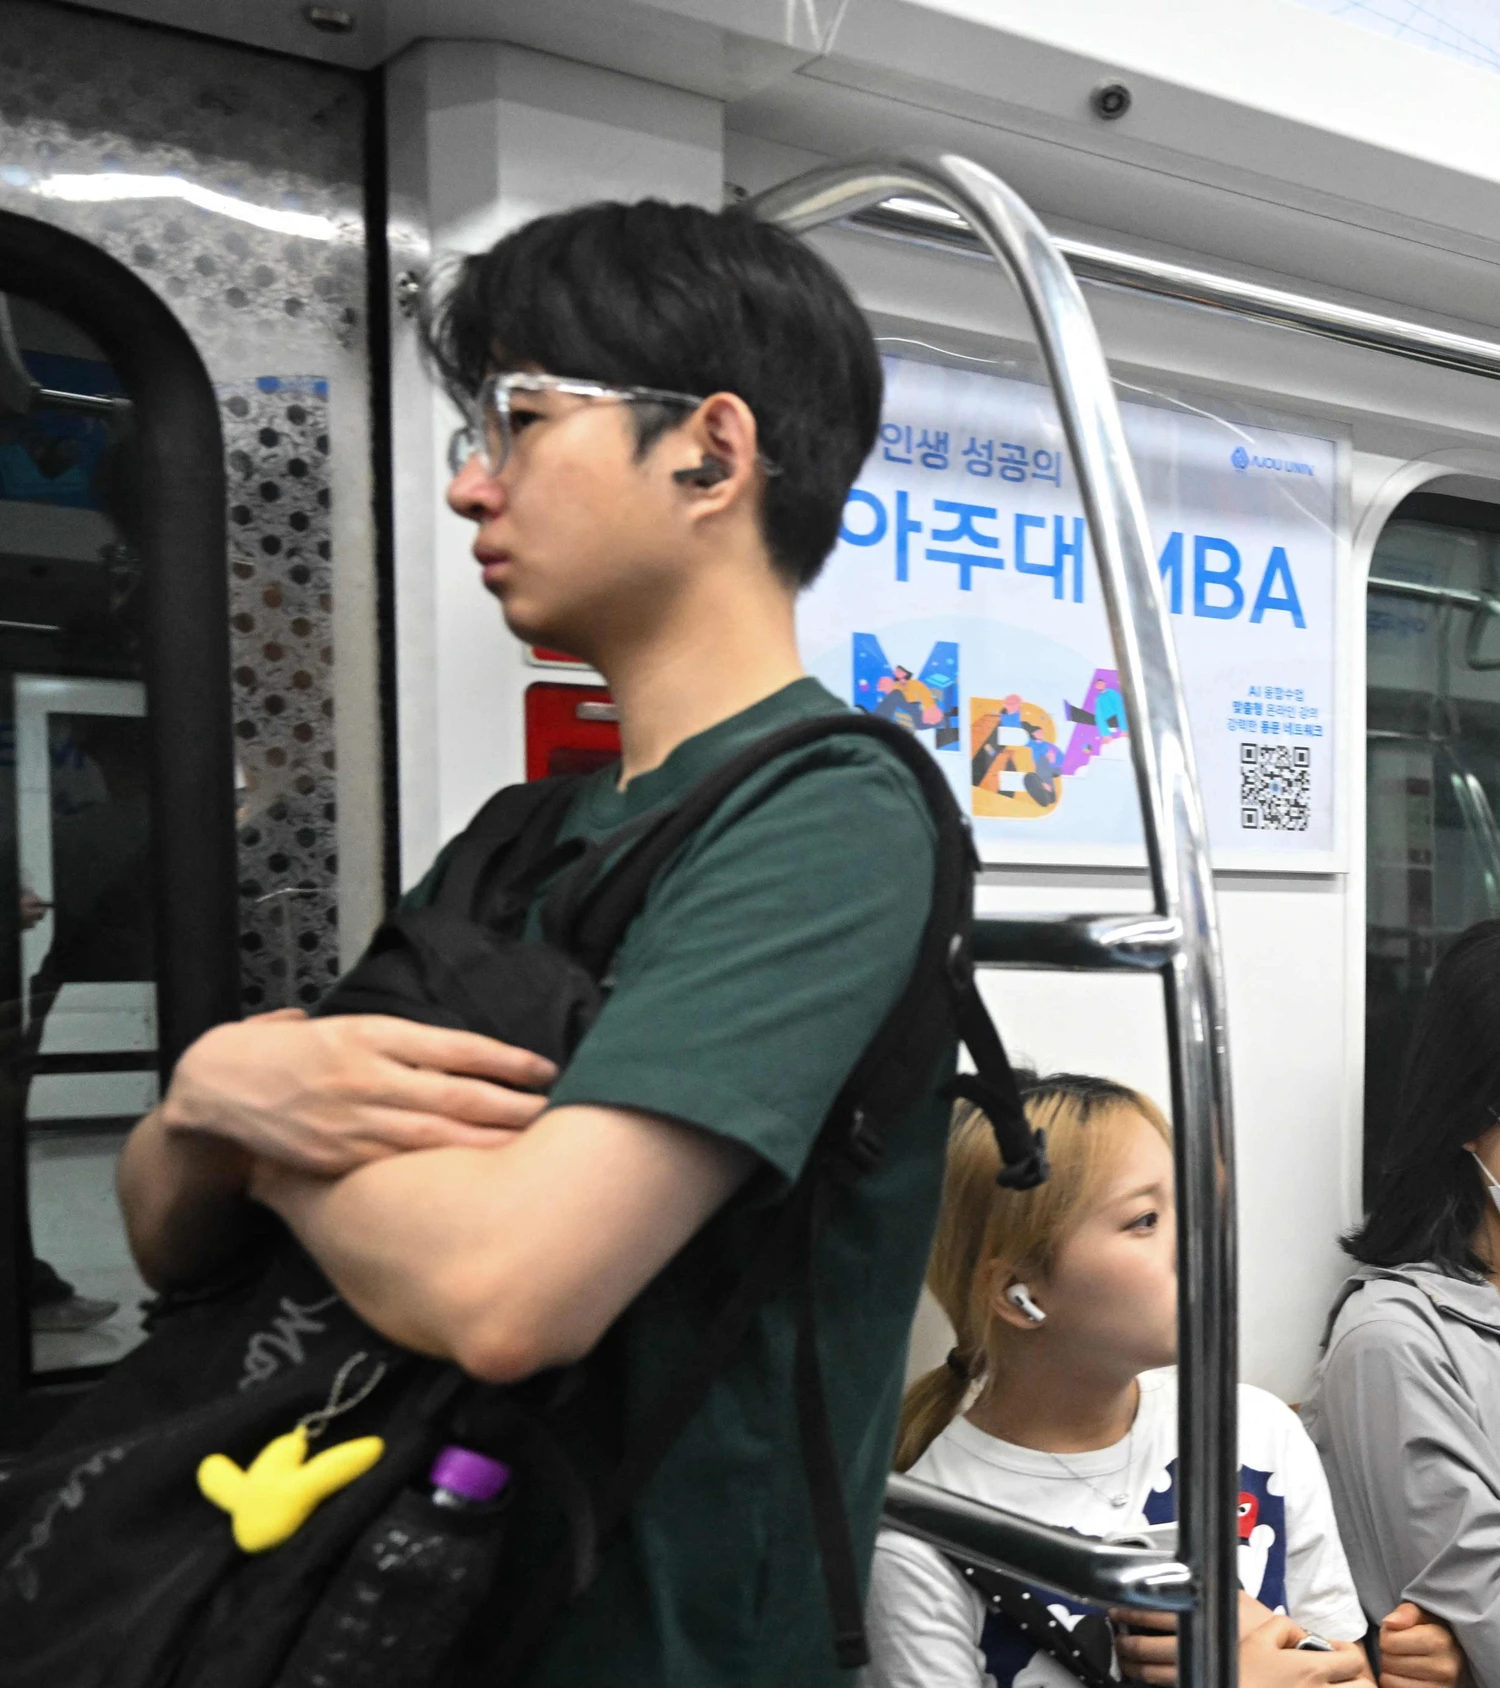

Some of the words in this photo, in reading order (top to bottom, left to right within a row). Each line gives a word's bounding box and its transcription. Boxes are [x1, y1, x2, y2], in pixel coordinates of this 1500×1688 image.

[880, 423, 949, 470] 인생
[961, 437, 1063, 488] 성공의
[838, 489, 1085, 604] 아주대
[1232, 701, 1262, 716] 맞춤형
[1266, 703, 1296, 719] 온라인
[1284, 723, 1323, 737] 네트워크
